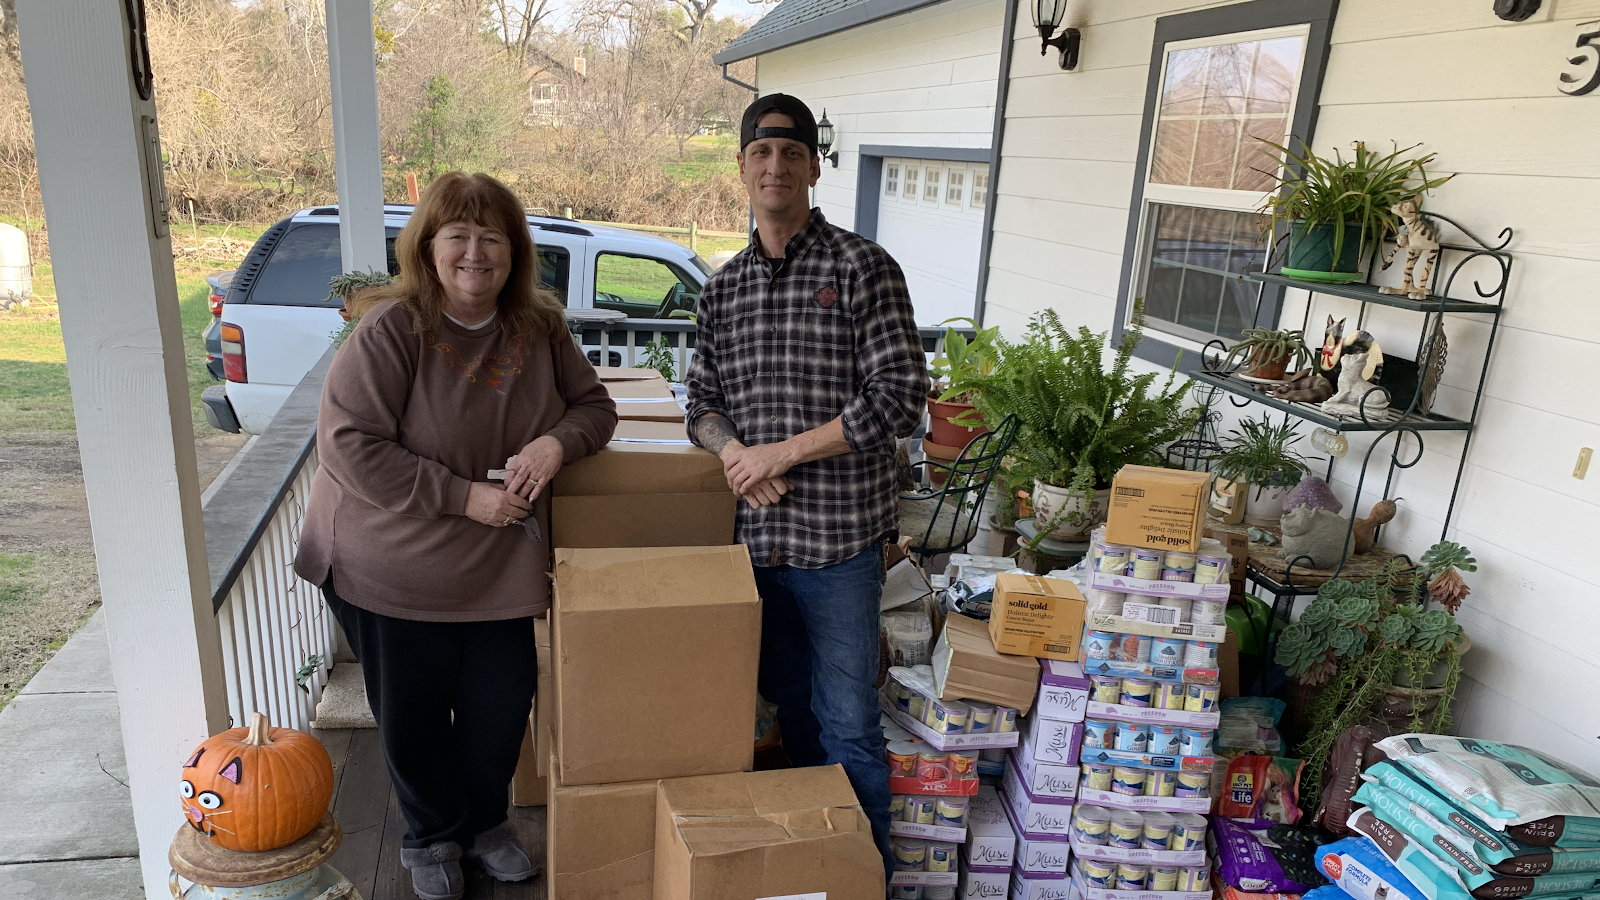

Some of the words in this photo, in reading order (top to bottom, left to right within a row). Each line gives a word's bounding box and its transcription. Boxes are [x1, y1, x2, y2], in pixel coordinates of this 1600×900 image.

[1557, 21, 1600, 96] 5
[1145, 534, 1167, 544] gold
[1166, 527, 1191, 536] Holistic
[1167, 537, 1190, 547] solid
[1007, 609, 1030, 617] Holistic
[1008, 600, 1029, 609] solid
[1029, 602, 1049, 611] gold
[1045, 691, 1086, 711] Muse
[1045, 725, 1067, 760] Muse
[922, 783, 947, 792] ALPO
[1036, 775, 1075, 793] Muse
[1380, 770, 1439, 812] HOLISTIC
[1231, 791, 1252, 803] Life
[1028, 812, 1066, 830] Muse
[1369, 788, 1424, 836] HOLISTIC
[1370, 823, 1393, 847] GRAIN
[1374, 819, 1395, 839] FREE
[1454, 816, 1478, 835] GRAIN
[1478, 833, 1497, 848] FREE
[973, 845, 1010, 862] Muse
[1028, 851, 1065, 869] Muse
[1438, 838, 1460, 857] GRAIN
[1460, 855, 1478, 872] FREE
[1345, 867, 1369, 886] FORMULA
[1347, 863, 1372, 882] COMPLETE
[967, 880, 1005, 898] Muse
[1039, 887, 1067, 900] Muse
[1494, 885, 1528, 893] GRAIN
[1537, 879, 1593, 892] HOLISTIC
